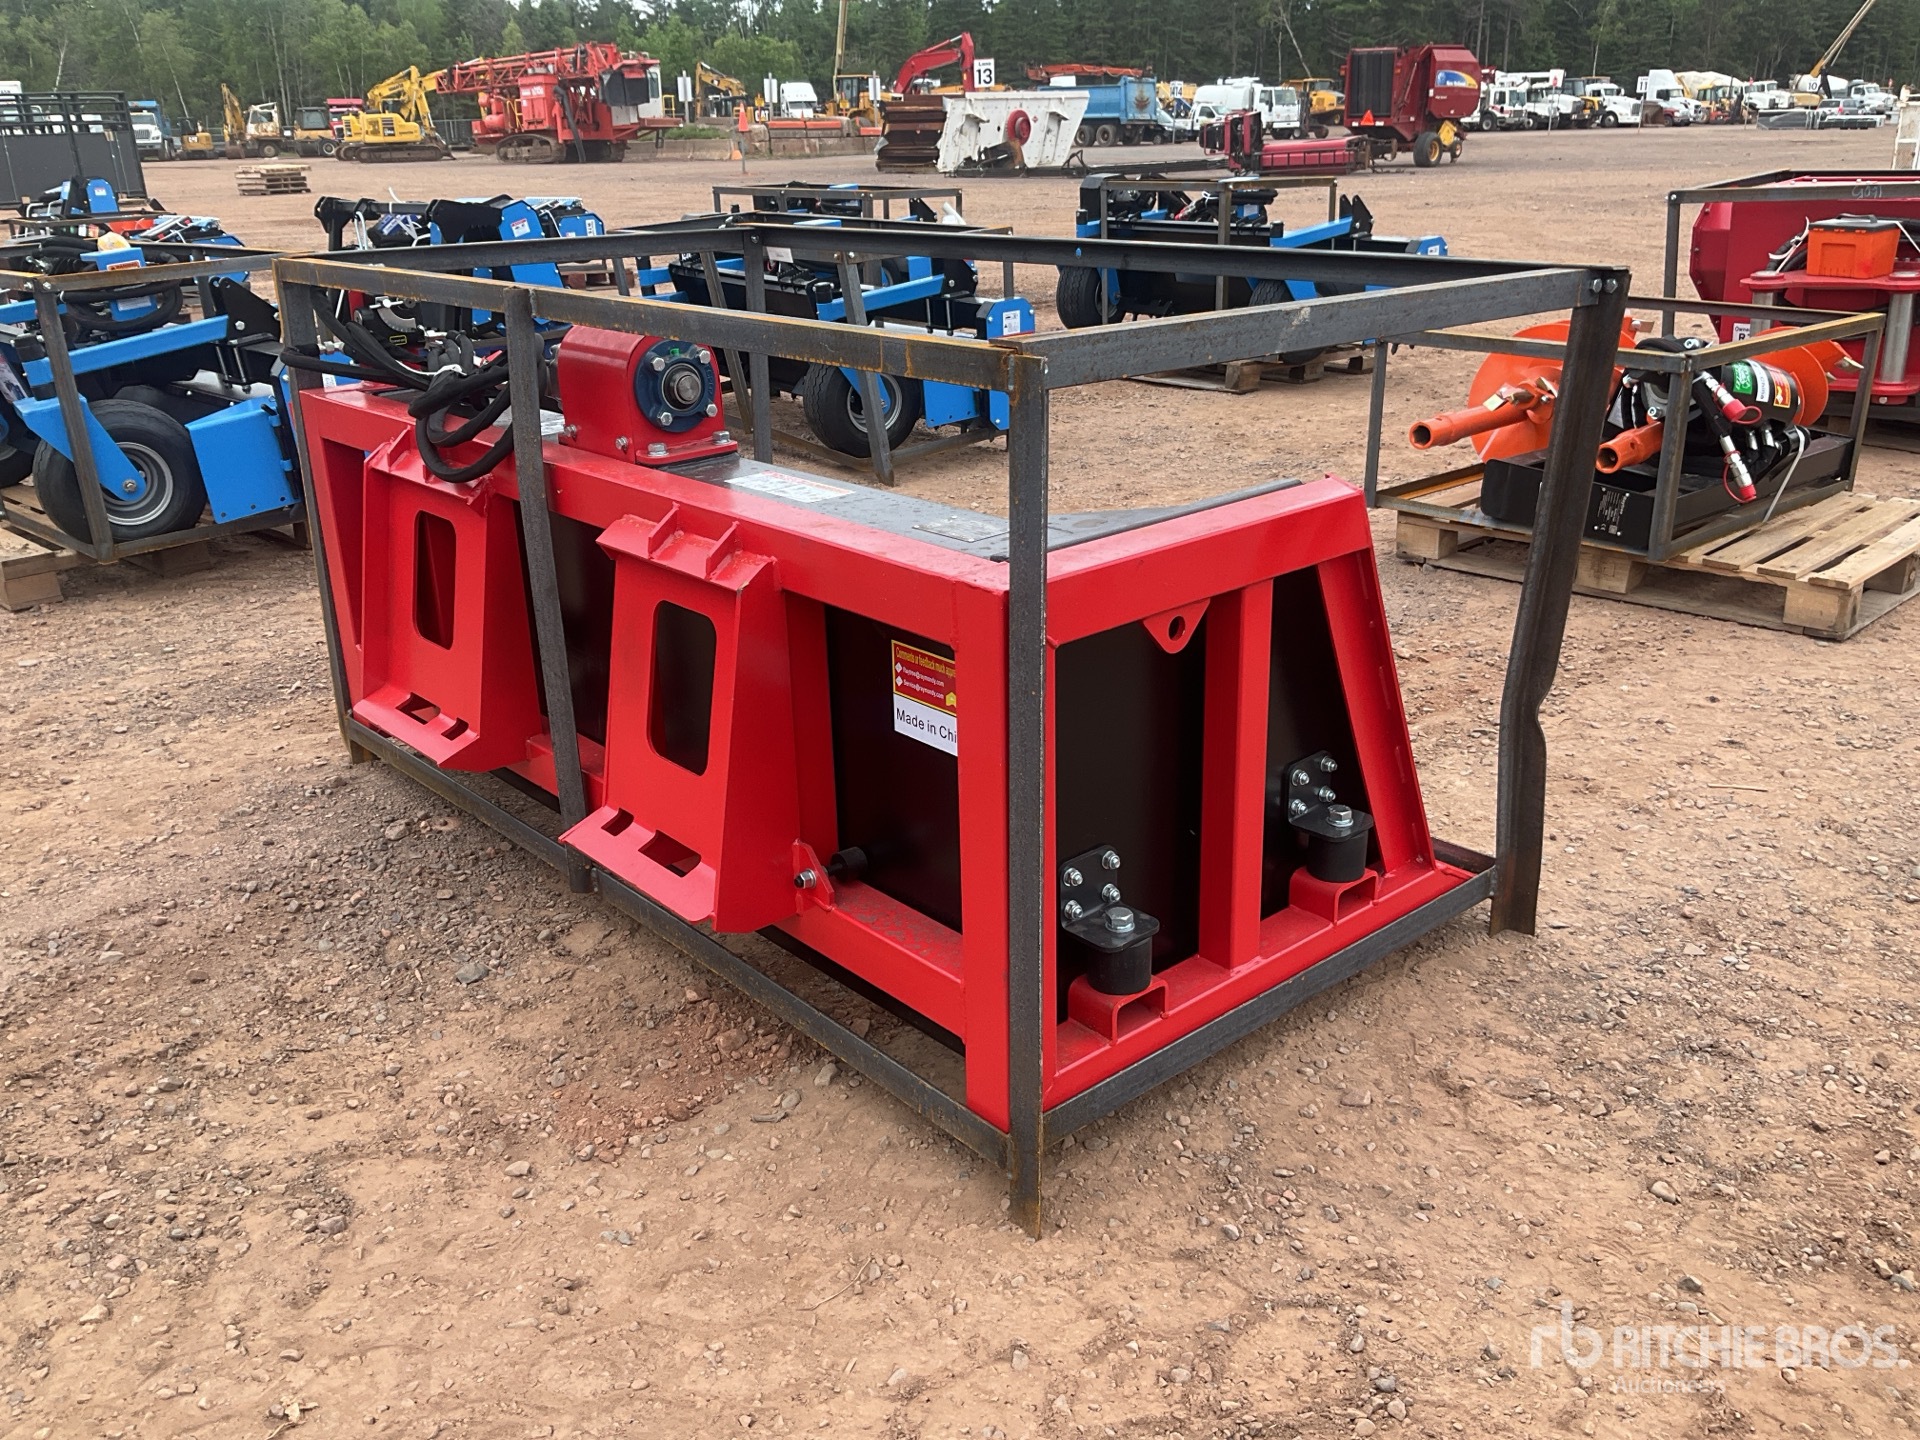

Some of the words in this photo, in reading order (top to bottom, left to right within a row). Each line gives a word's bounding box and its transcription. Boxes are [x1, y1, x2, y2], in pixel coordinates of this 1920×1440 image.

[976, 68, 993, 85] 13
[1808, 82, 1818, 91] 10
[896, 707, 925, 730] Made
[926, 720, 937, 735] in
